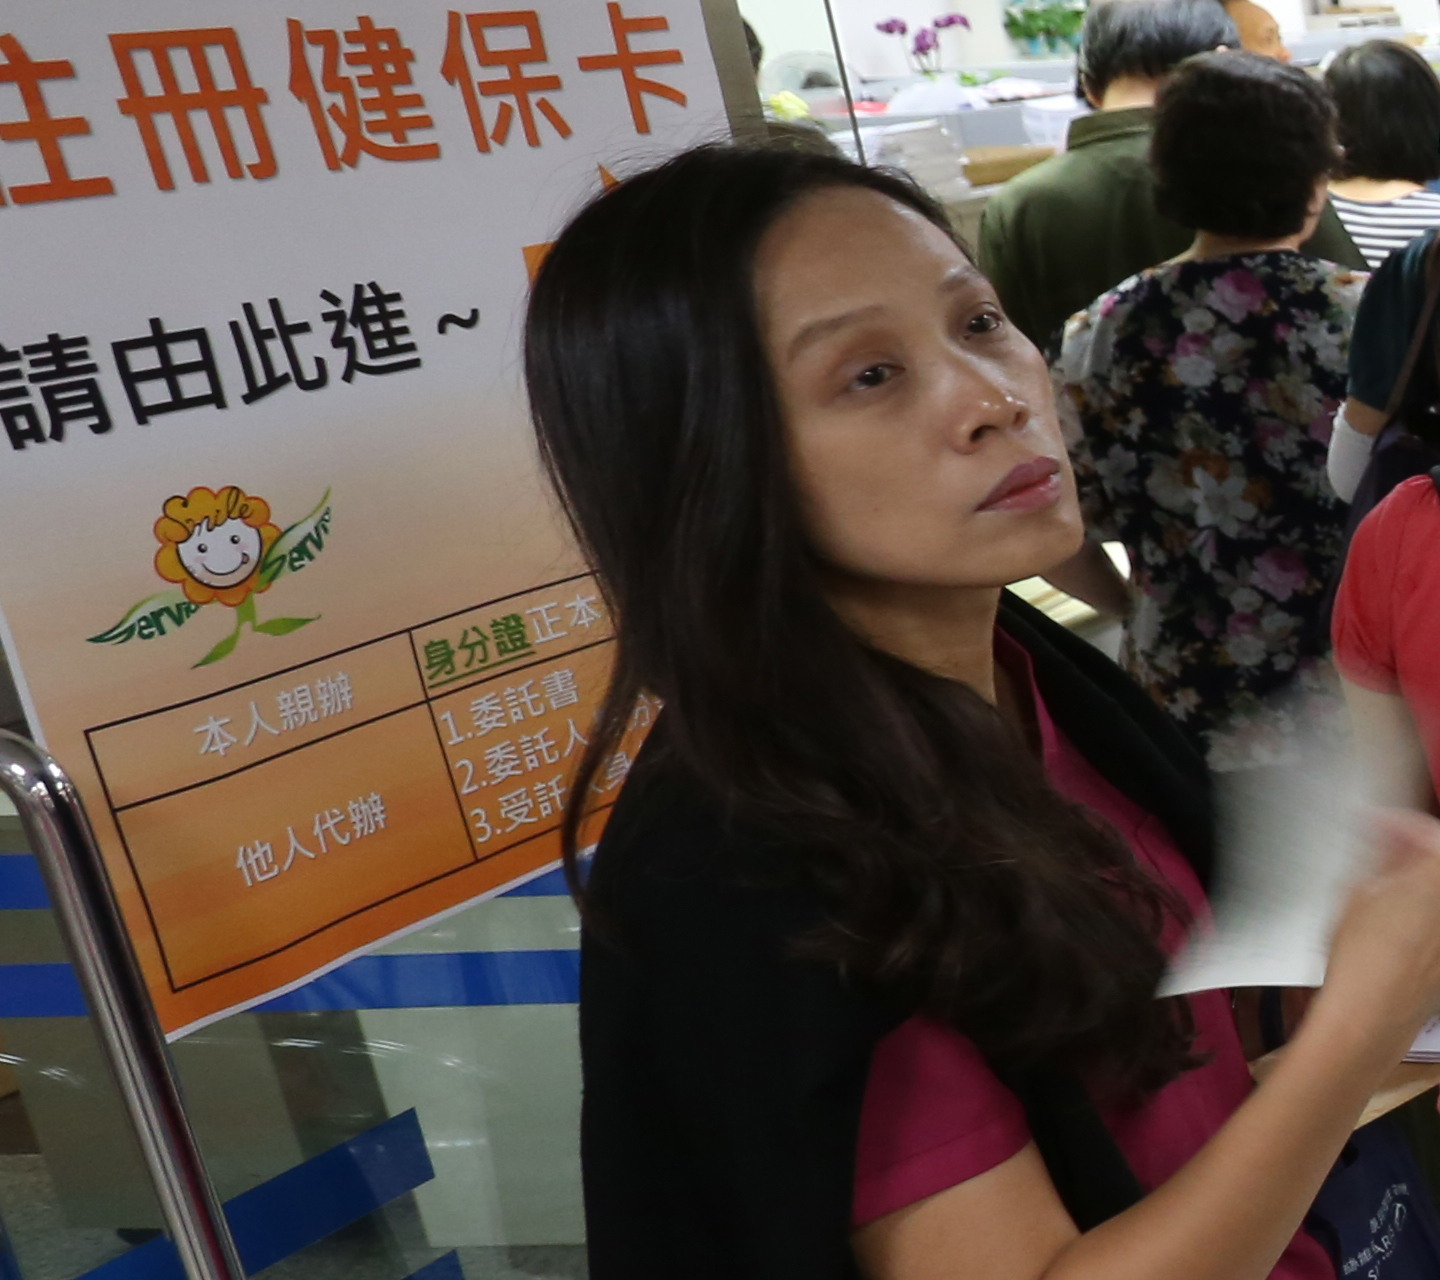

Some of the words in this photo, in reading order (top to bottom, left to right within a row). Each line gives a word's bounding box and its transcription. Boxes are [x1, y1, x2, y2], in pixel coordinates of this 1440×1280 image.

[423, 593, 602, 682] 身分證正本
[193, 671, 354, 758] 本人親辦
[440, 667, 580, 746] 1.委託書
[235, 790, 388, 887] 他人代辦
